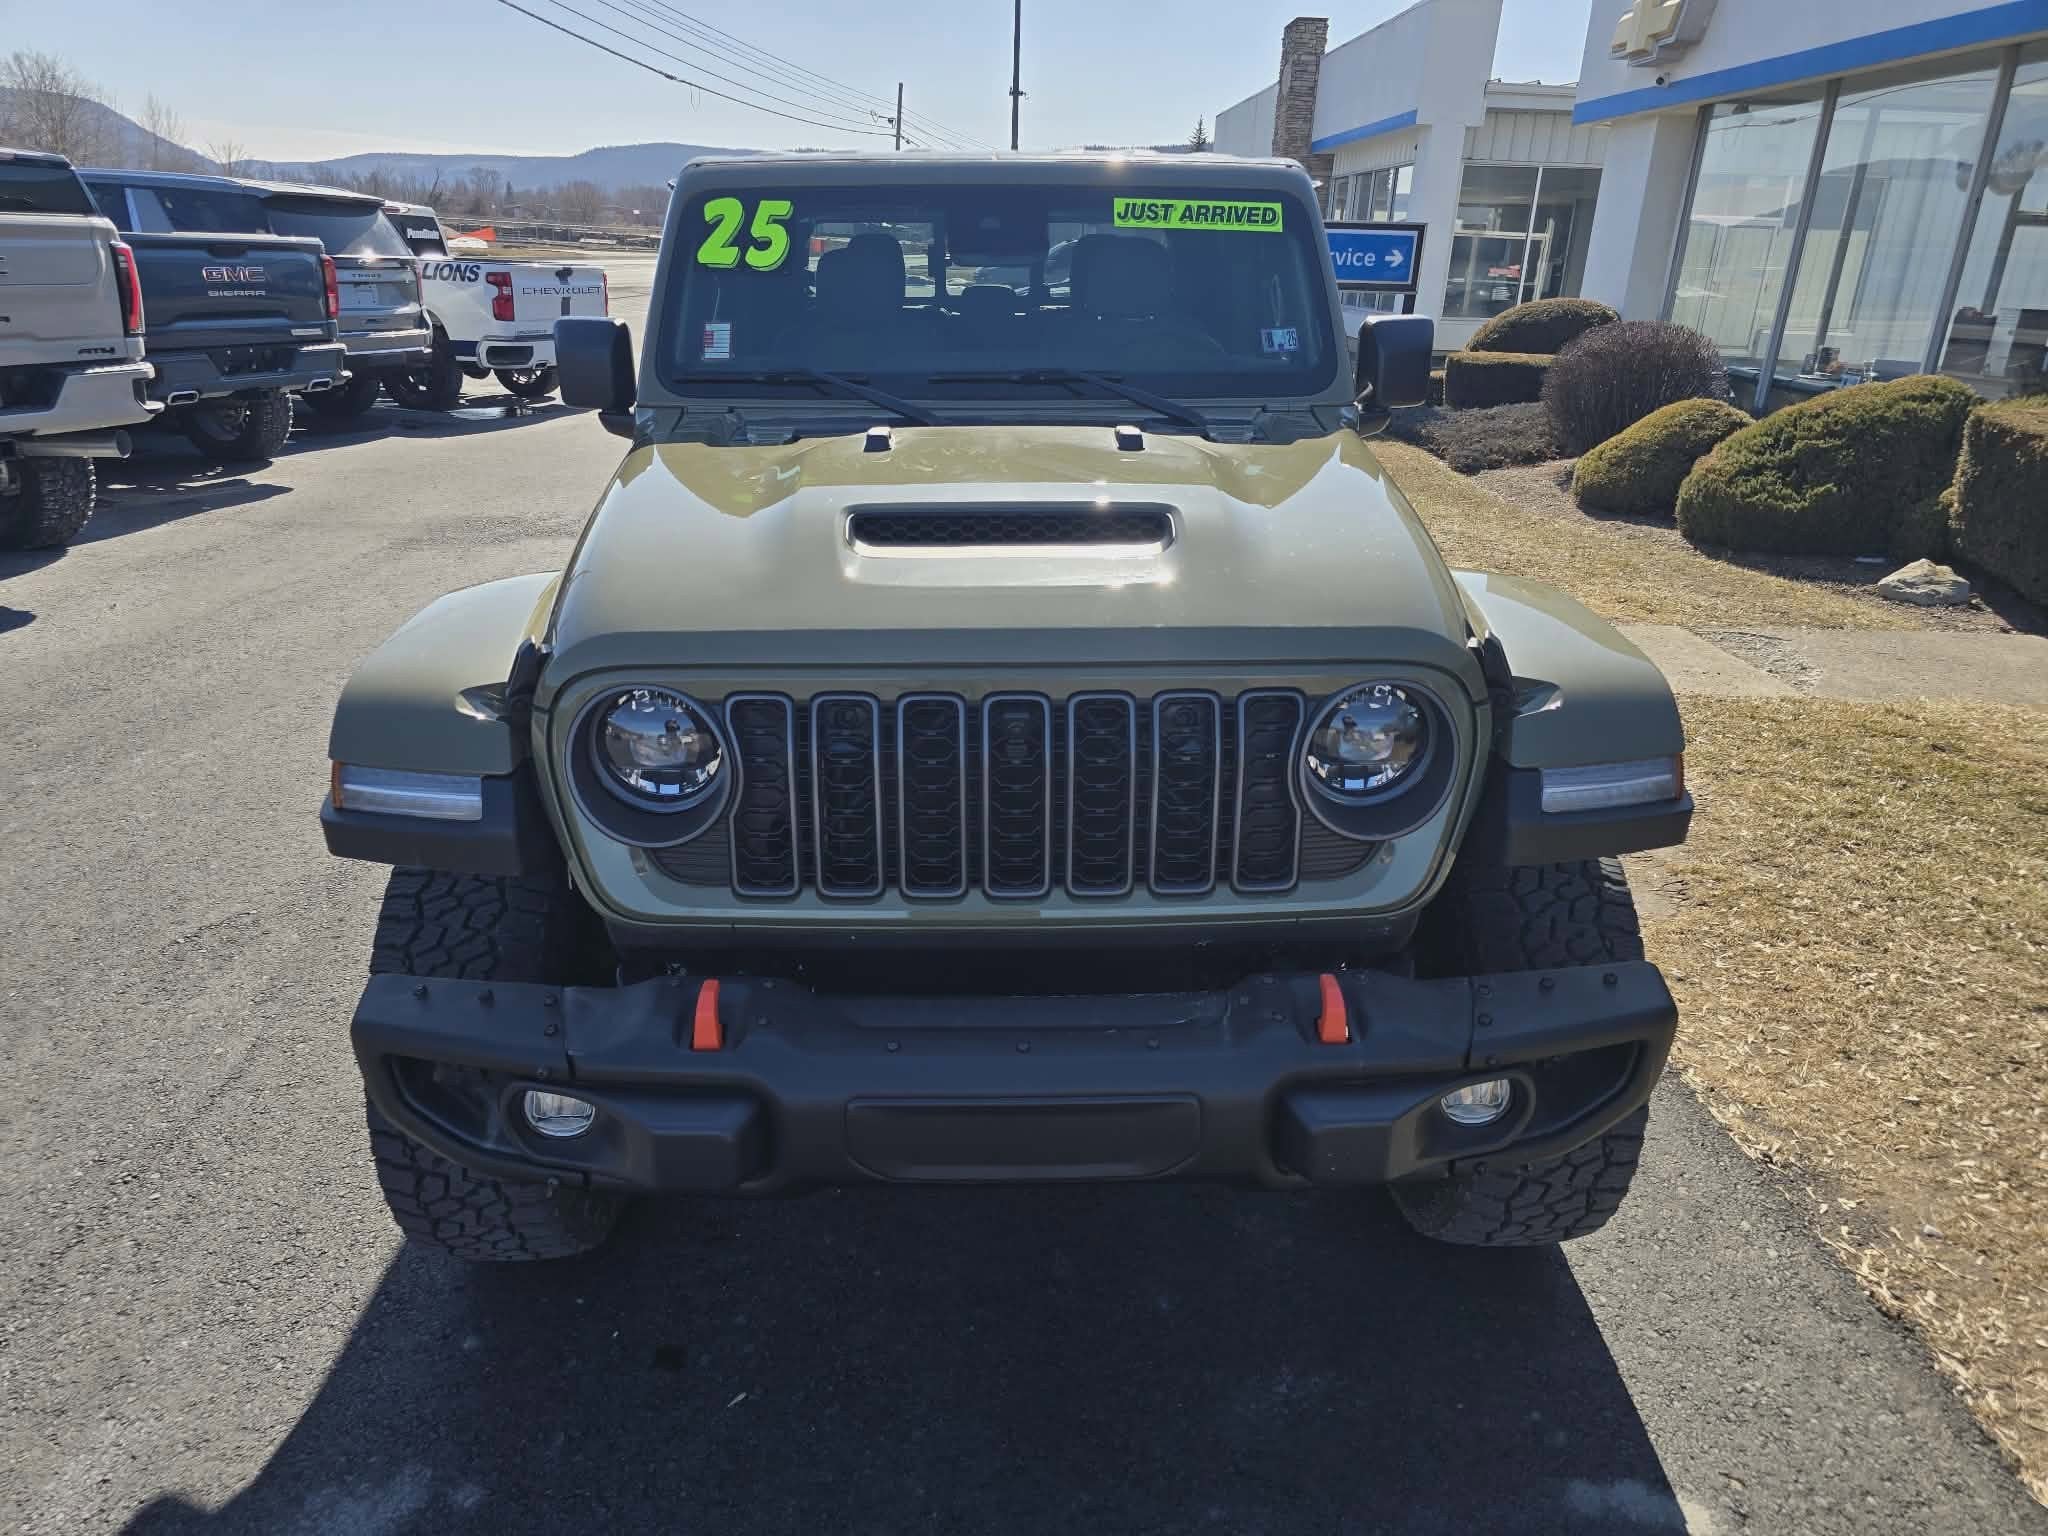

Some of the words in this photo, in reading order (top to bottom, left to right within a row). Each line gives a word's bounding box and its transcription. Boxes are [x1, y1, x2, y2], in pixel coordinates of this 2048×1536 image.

[1117, 202, 1176, 222] JUST
[1179, 204, 1279, 225] ARRIVED
[697, 197, 793, 271] 25
[202, 267, 265, 282] GMC
[422, 263, 481, 282] LIONS
[522, 287, 601, 295] CHEVROLET
